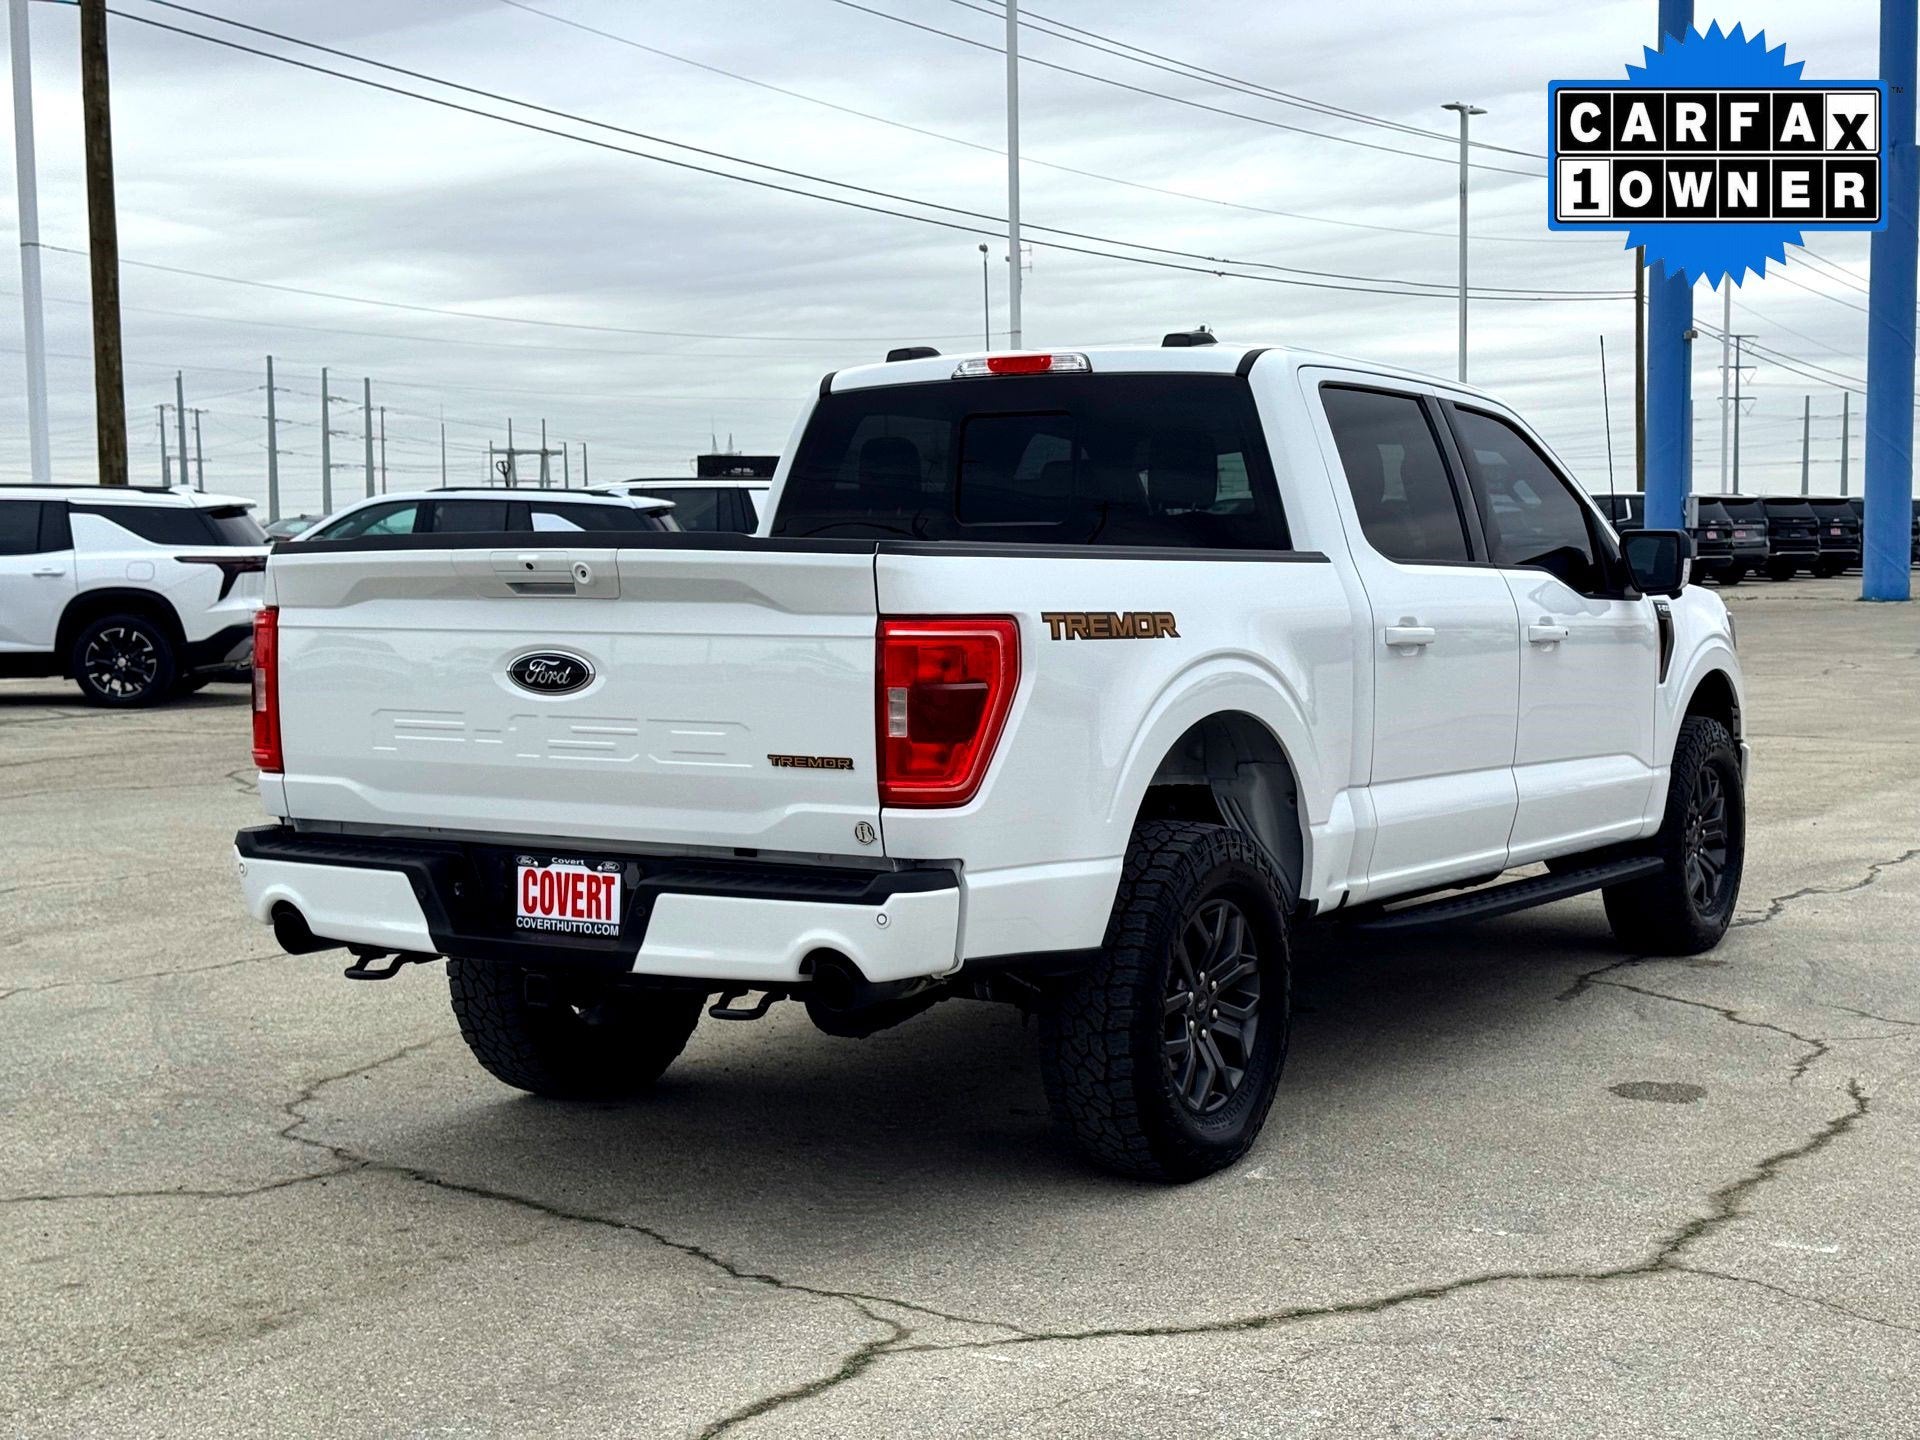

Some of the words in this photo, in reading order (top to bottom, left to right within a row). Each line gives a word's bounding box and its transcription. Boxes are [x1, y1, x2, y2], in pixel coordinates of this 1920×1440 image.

[1040, 611, 1182, 641] TREMOR
[525, 658, 572, 685] Ford
[767, 753, 855, 771] TREMOR
[551, 856, 585, 866] Covert
[523, 868, 616, 921] COVERT
[516, 917, 619, 936] COVERTHUTTO.COM
